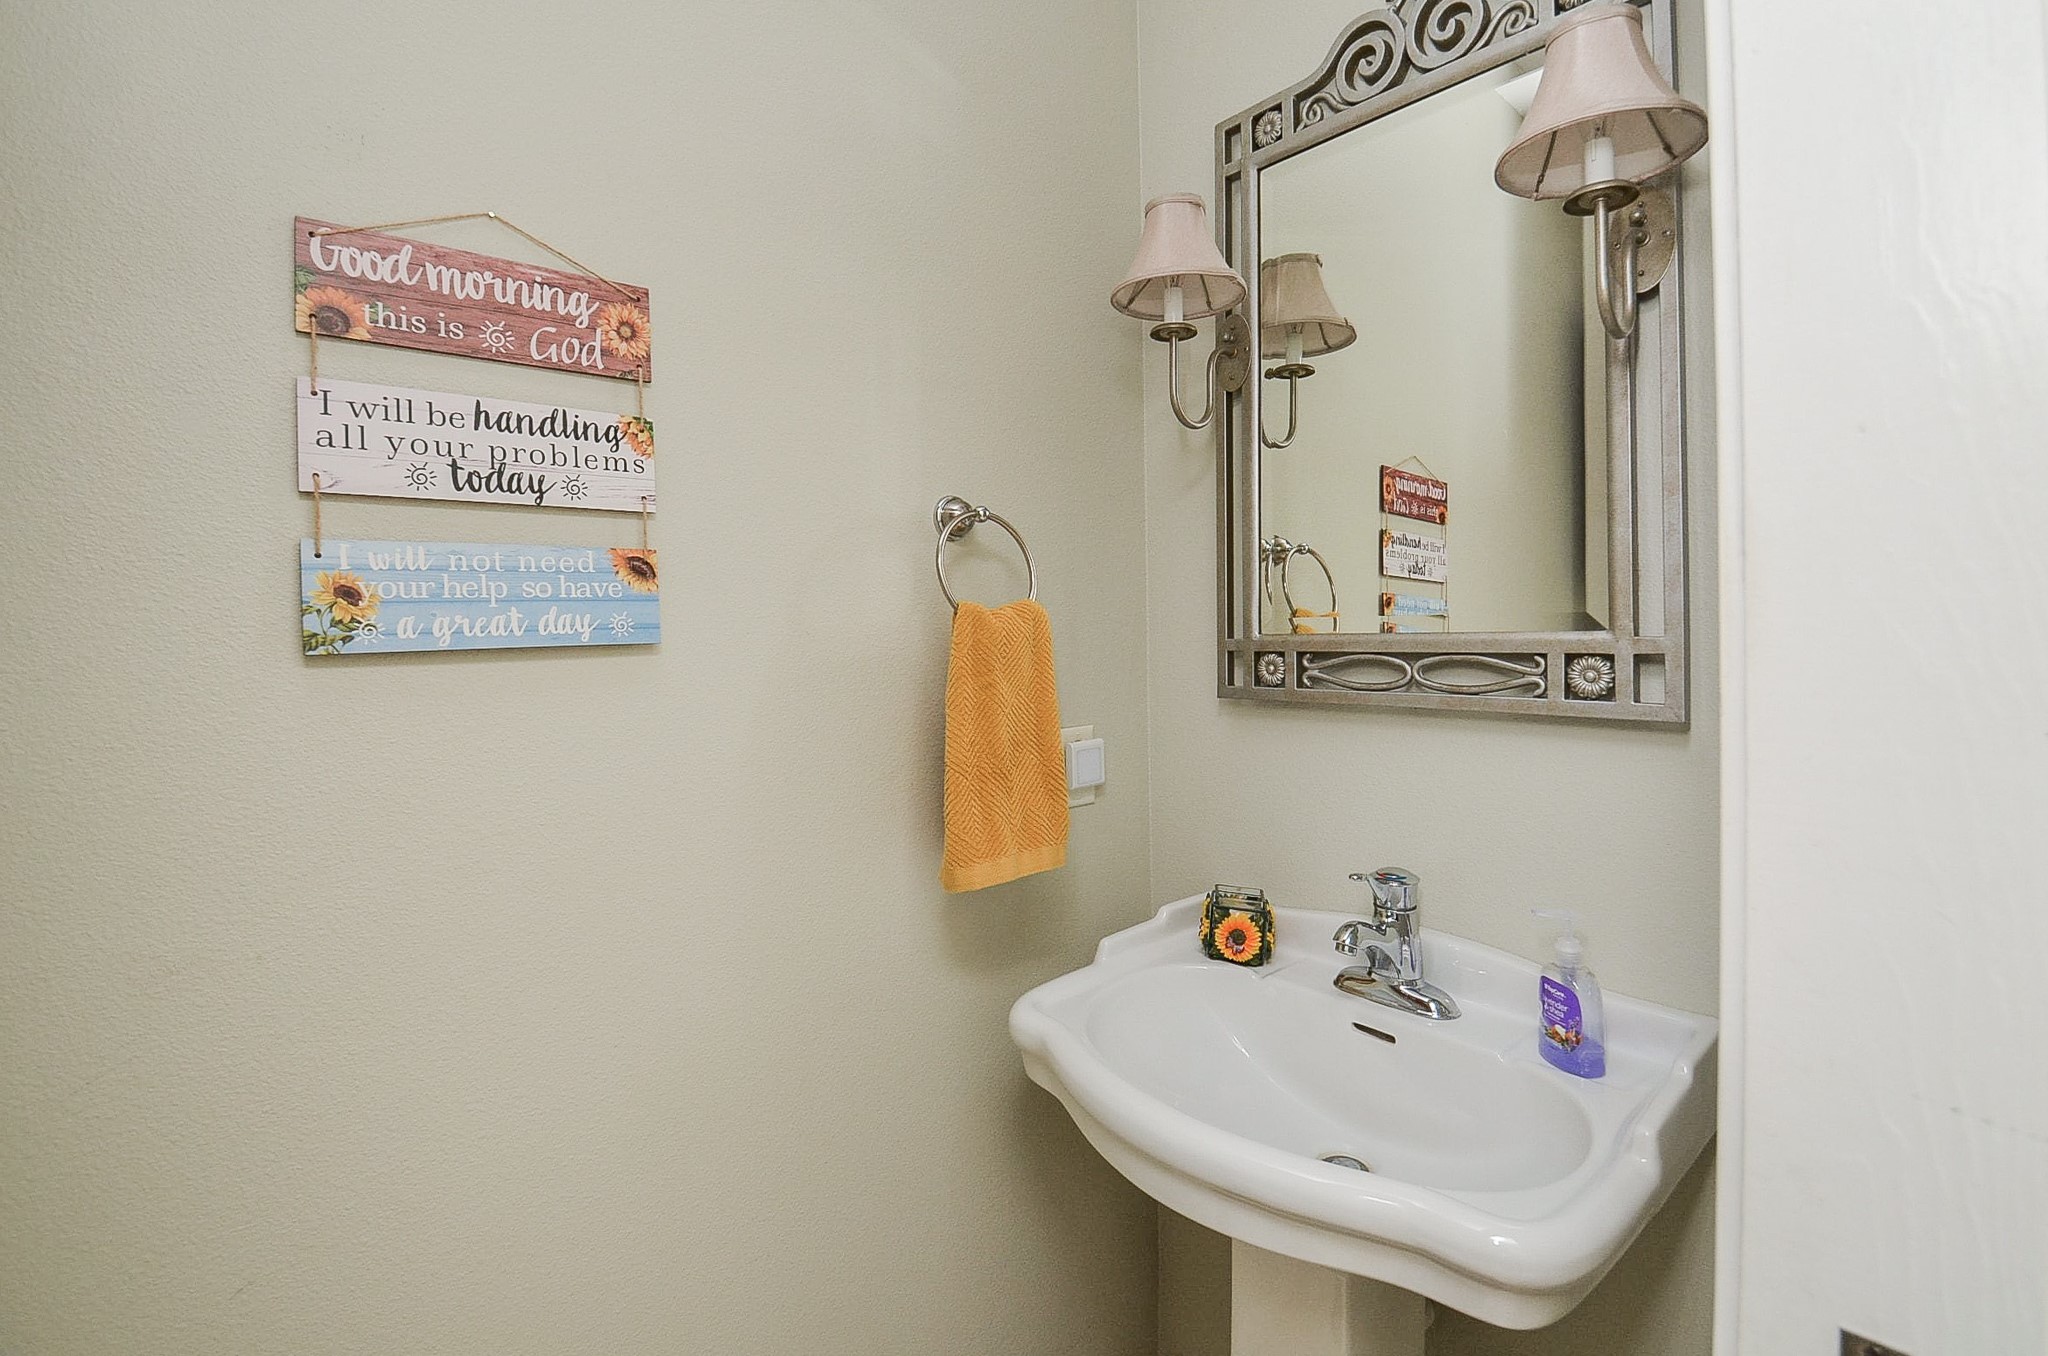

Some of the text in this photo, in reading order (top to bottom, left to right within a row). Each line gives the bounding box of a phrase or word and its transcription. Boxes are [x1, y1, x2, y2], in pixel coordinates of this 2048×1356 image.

[310, 227, 599, 328] Good morning
[361, 301, 605, 370] this is God
[319, 389, 629, 453] I will be handling
[315, 424, 646, 475] all your problems
[446, 458, 557, 506] today
[338, 543, 596, 573] I will not need
[356, 574, 623, 607] your help so have
[397, 606, 602, 646] a great day
